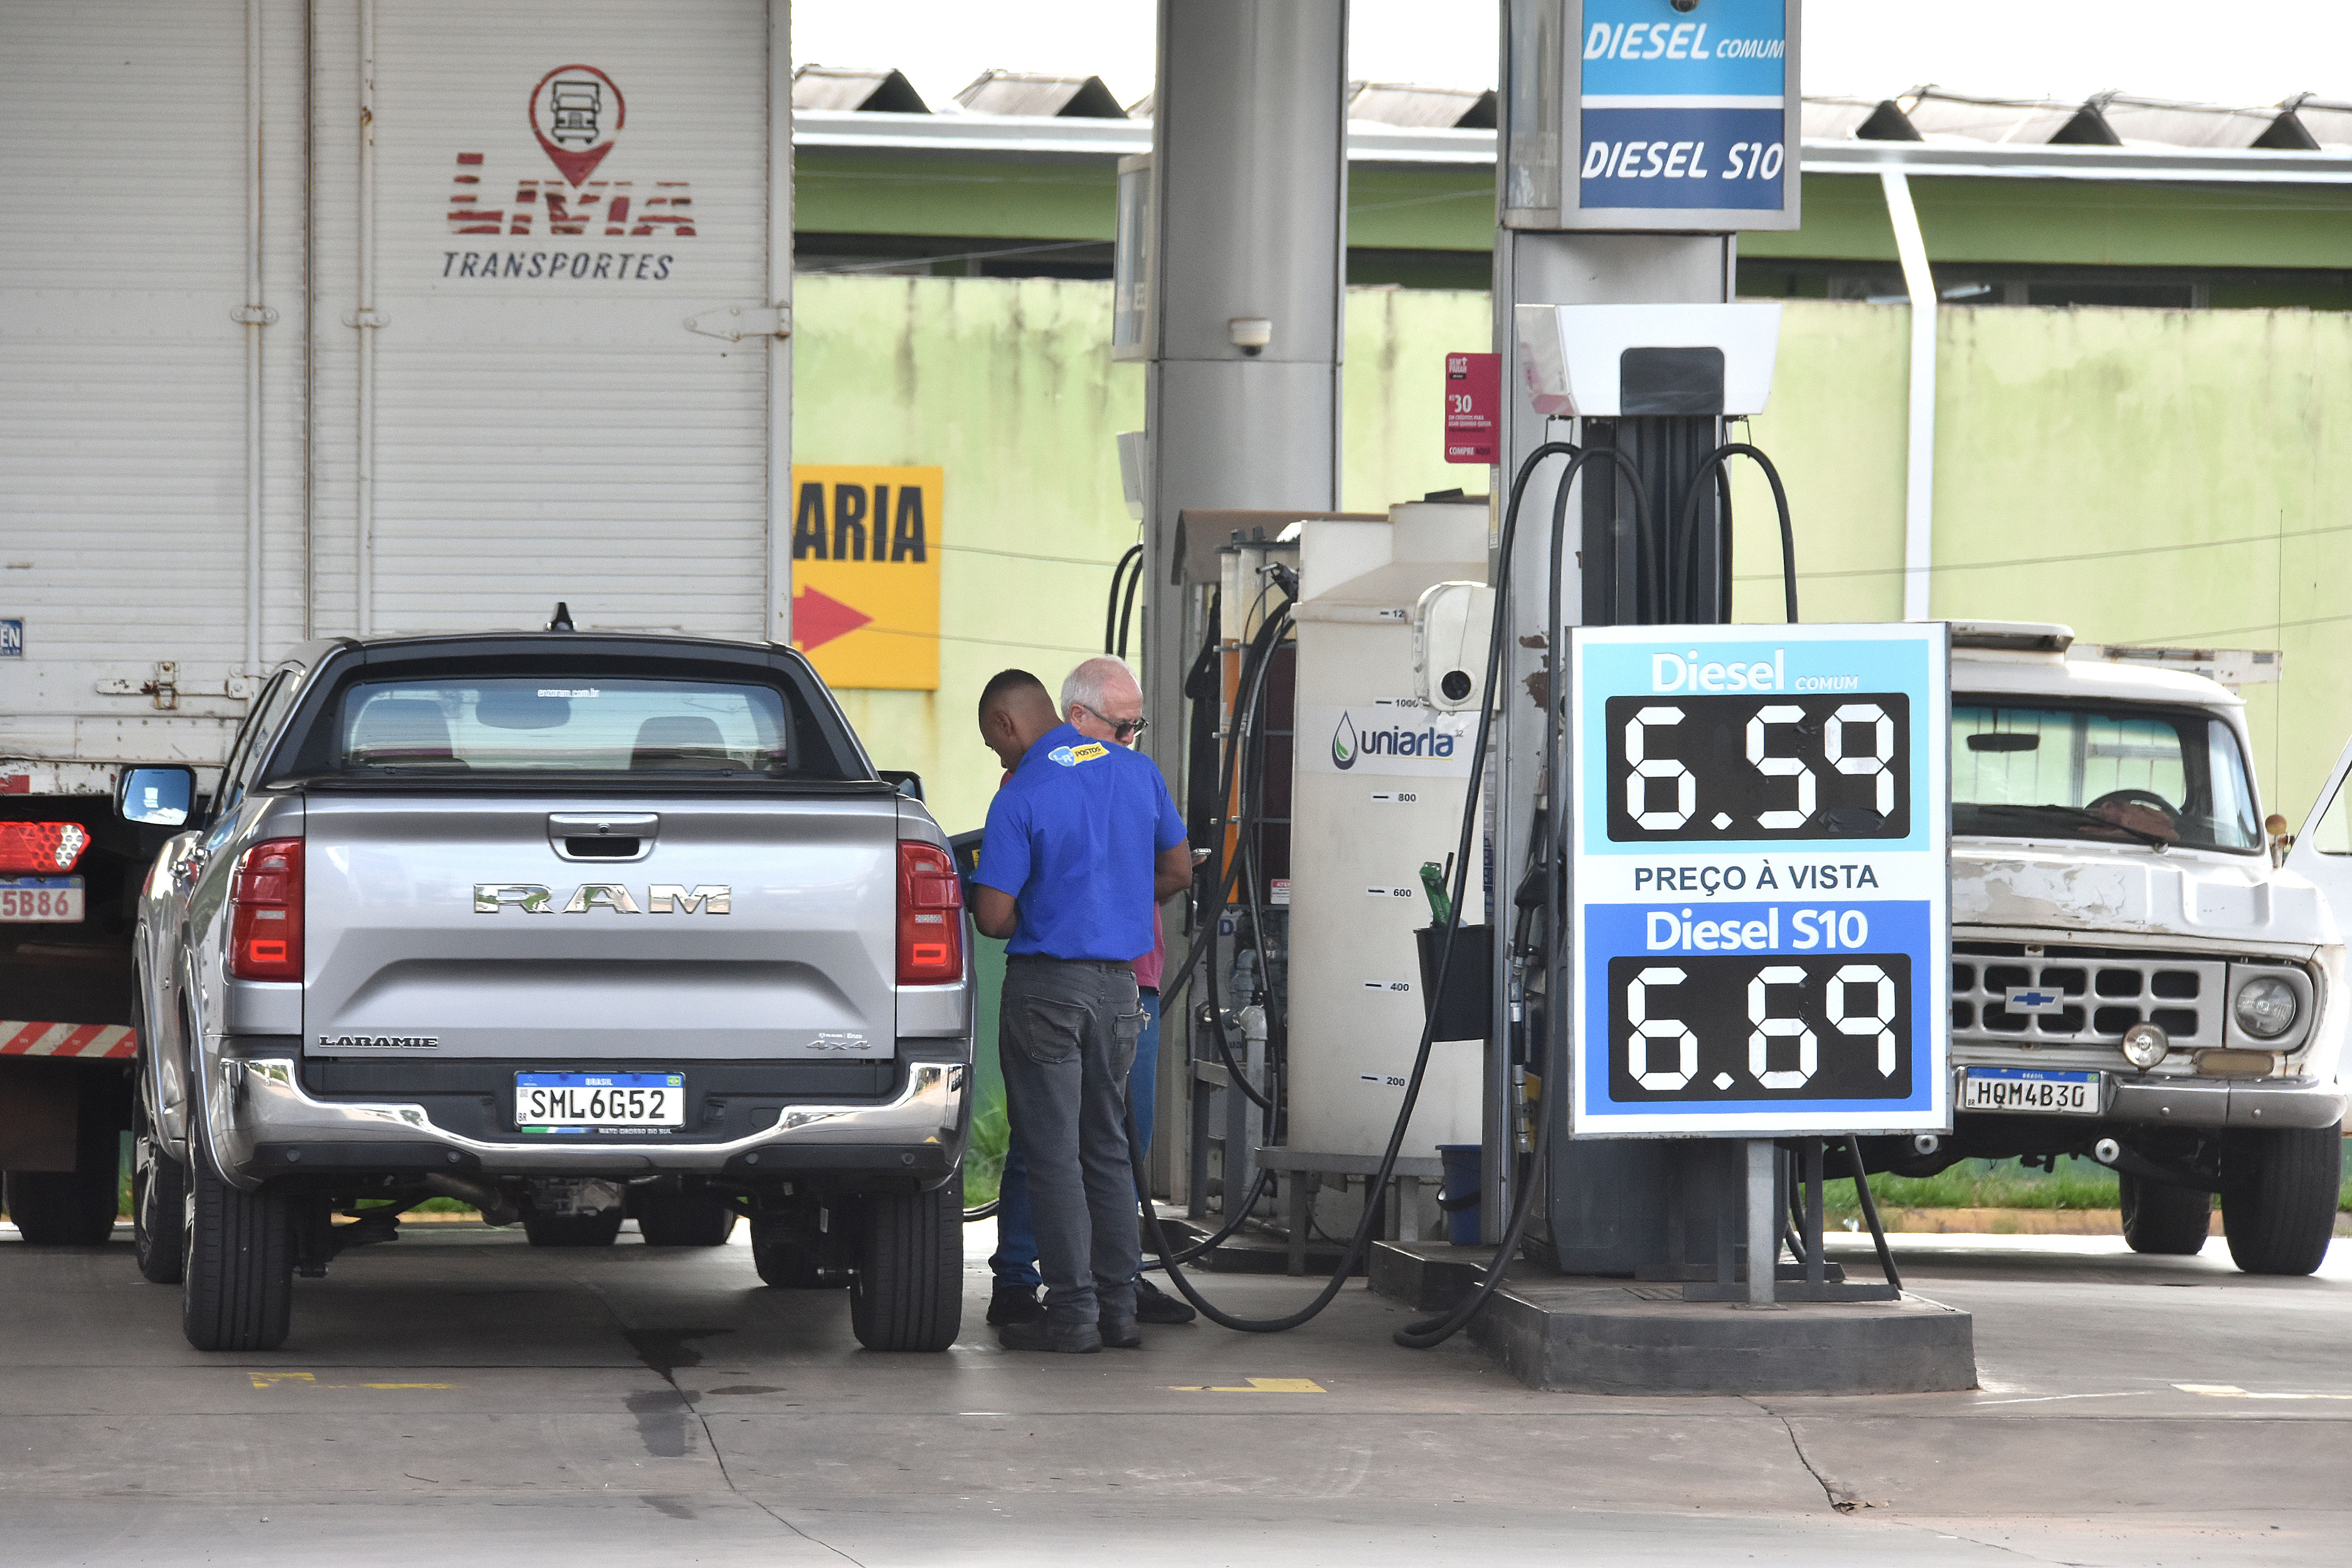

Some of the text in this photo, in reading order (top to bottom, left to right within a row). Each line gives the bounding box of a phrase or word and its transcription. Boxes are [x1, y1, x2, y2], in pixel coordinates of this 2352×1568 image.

[1583, 23, 1785, 60] DIESEL COMUM
[1581, 141, 1784, 180] DIESEL S10
[443, 252, 674, 280] TRANSPORTES
[1454, 395, 1472, 413] 30
[1449, 447, 1475, 455] COMPRE
[793, 483, 926, 561] ARIA
[1652, 649, 1859, 691] Diesel COMUM
[1075, 746, 1101, 757] POSTOS
[1362, 725, 1453, 757] uniarla
[1626, 704, 1894, 830] 6.59
[1398, 793, 1416, 802] 800
[1635, 859, 1879, 896] PREÇO À VISTA
[0, 891, 68, 916] 5B86
[474, 883, 732, 914] RAM
[1393, 889, 1411, 897] 600
[1646, 907, 1868, 950] Diesel S10
[1391, 983, 1409, 992] 400
[1628, 965, 1896, 1091] 6.69
[319, 1036, 438, 1049] LARAMIE
[806, 1040, 871, 1051] 4x4
[1387, 1076, 1405, 1086] 200
[531, 1089, 665, 1119] SML6G52
[1968, 1098, 1975, 1106] BR
[1978, 1082, 2084, 1107] HQM4B30
[517, 1113, 527, 1122] BR
